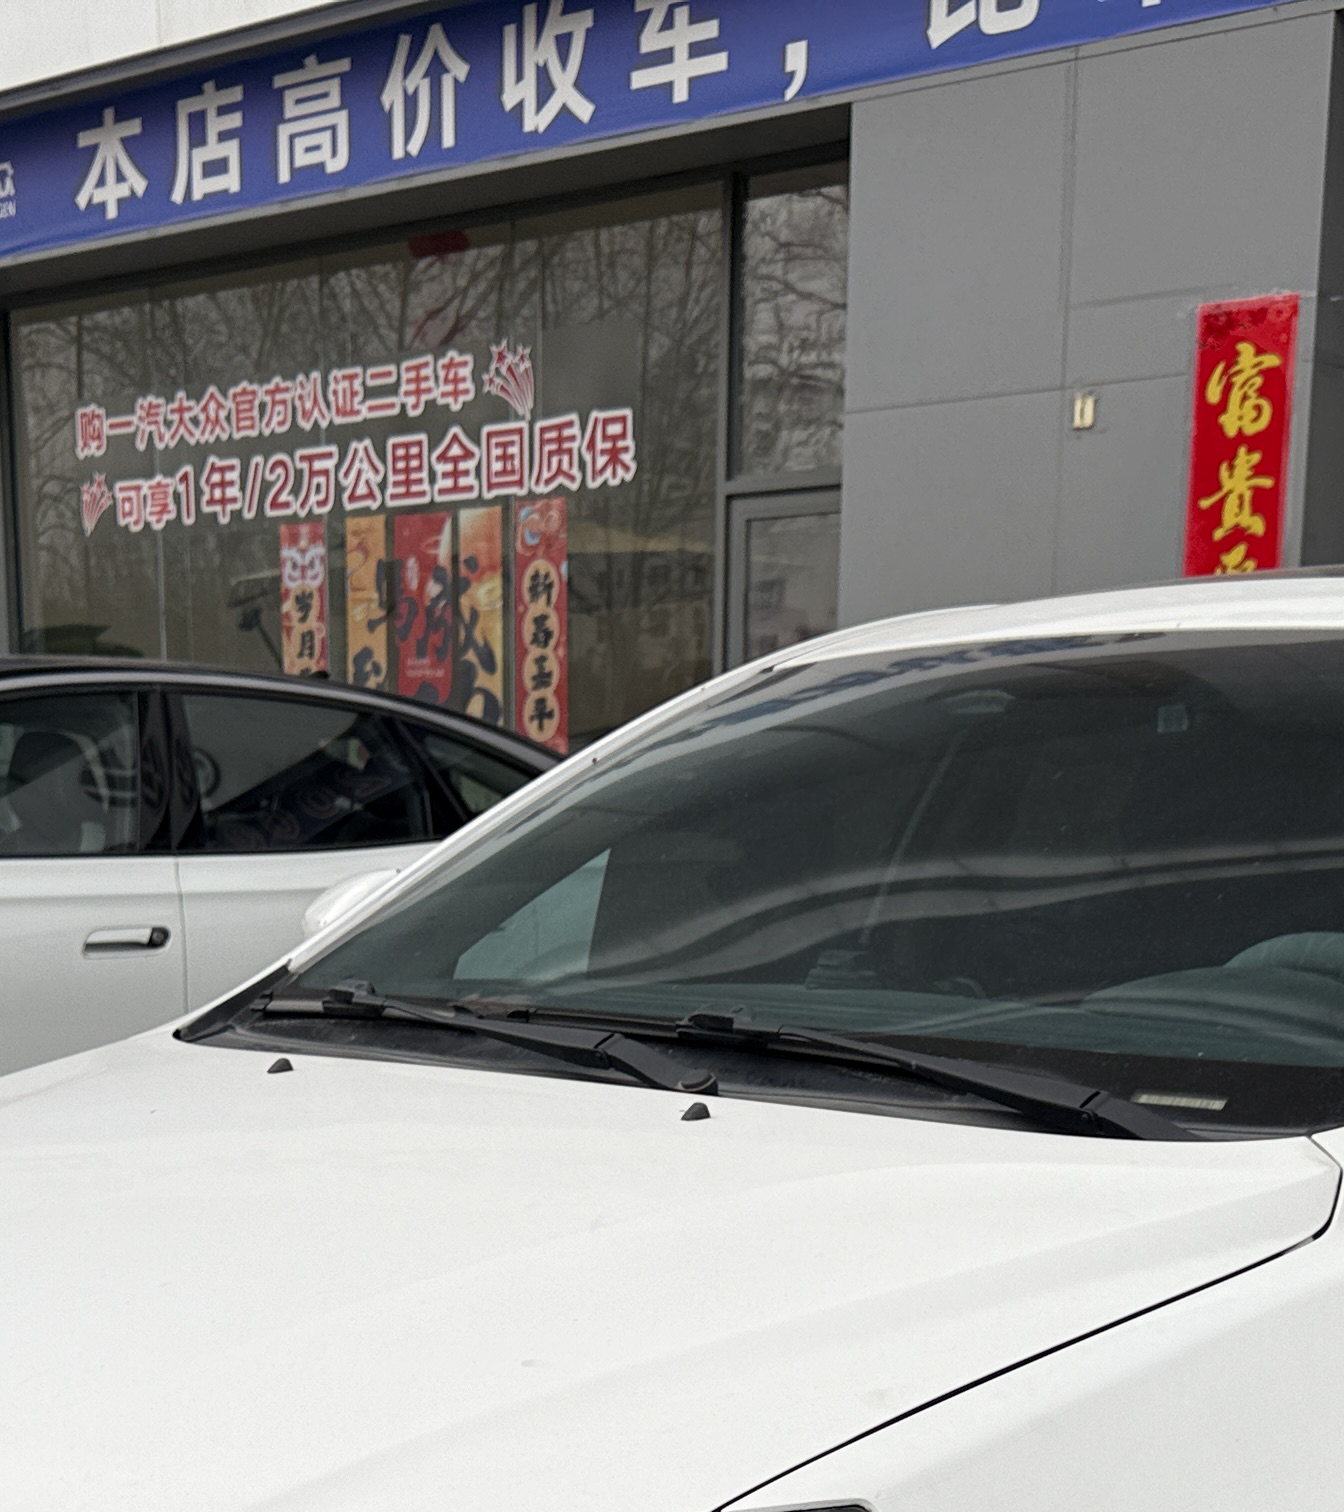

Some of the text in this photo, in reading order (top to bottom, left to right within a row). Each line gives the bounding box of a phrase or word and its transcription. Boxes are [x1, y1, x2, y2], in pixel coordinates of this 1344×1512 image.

[74, 352, 475, 459] 购一汽大众官方认证二手车
[115, 408, 638, 532] 可享1年/2万公里全国质保
[294, 590, 317, 678] 岁月
